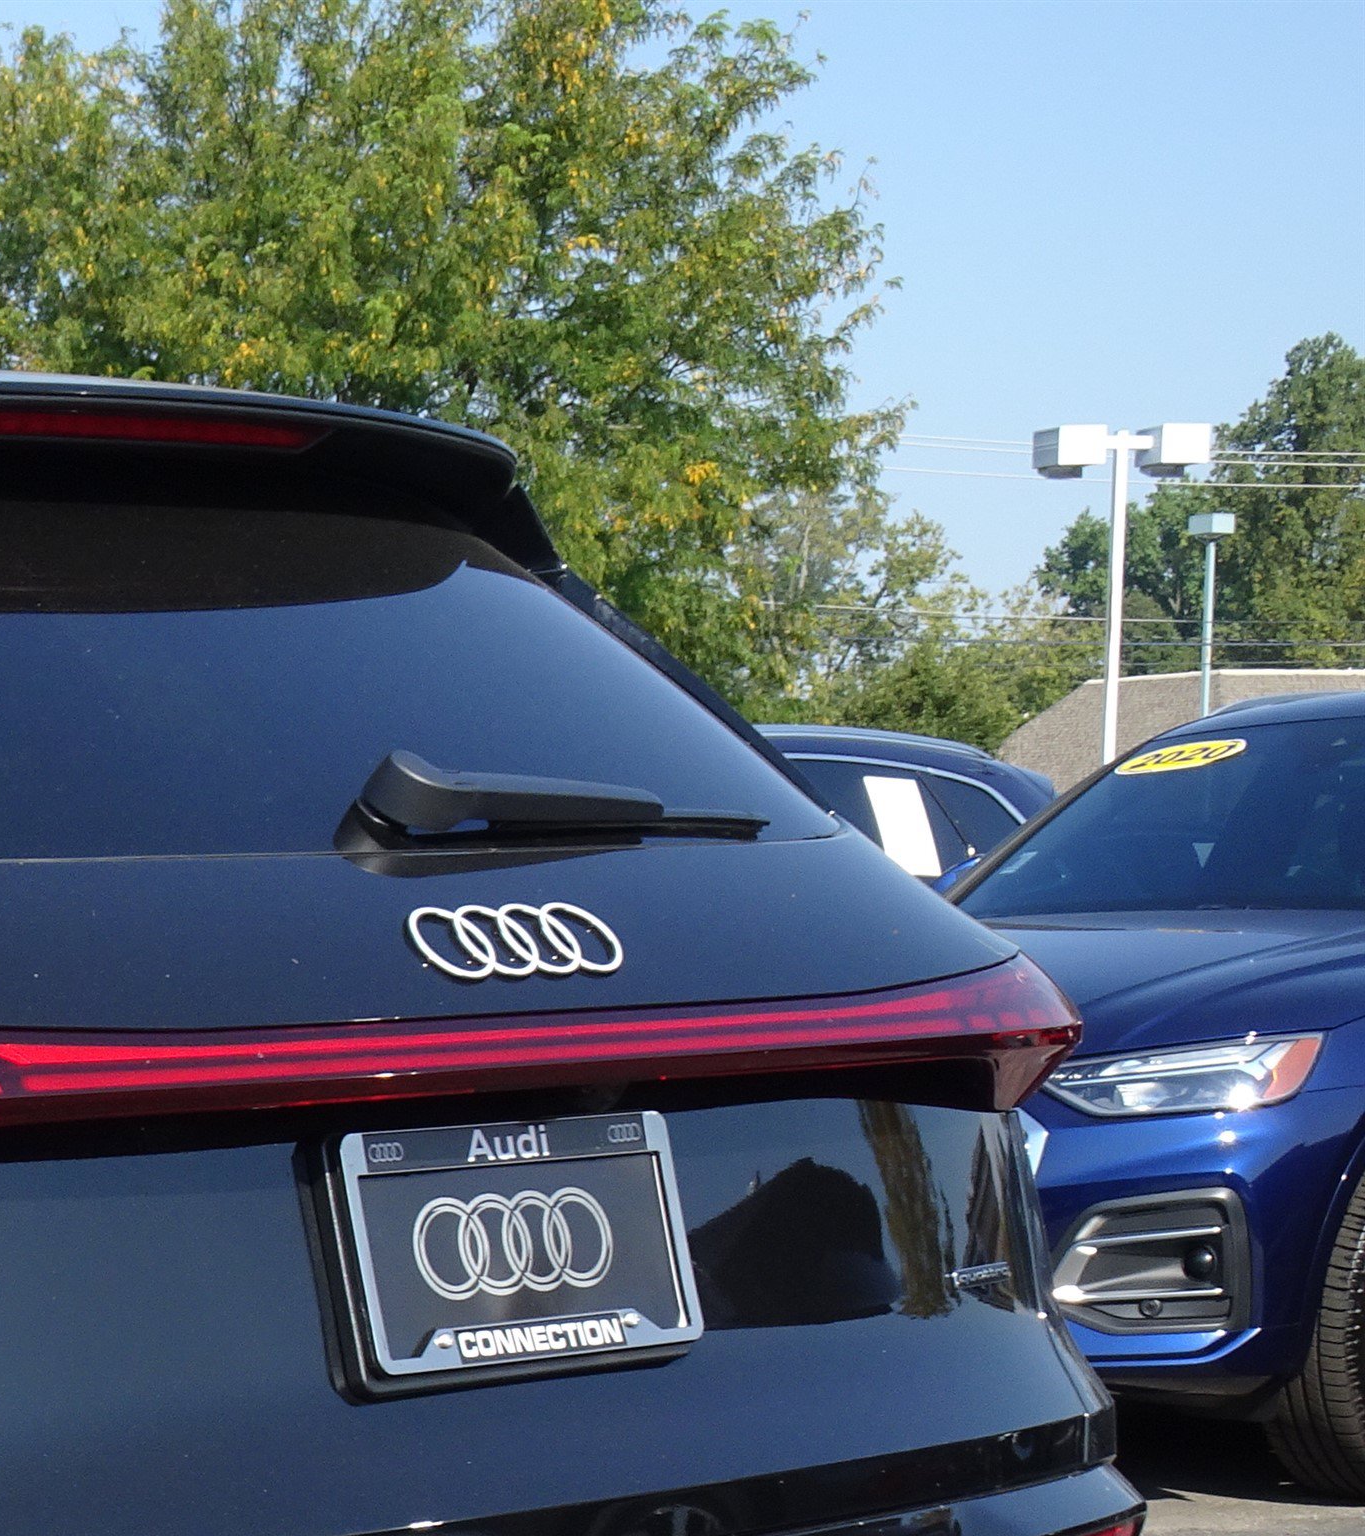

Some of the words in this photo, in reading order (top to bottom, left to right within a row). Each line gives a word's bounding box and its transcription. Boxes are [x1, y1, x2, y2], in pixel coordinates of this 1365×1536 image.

[1128, 743, 1236, 769] 2020
[467, 1124, 551, 1163] Audi
[457, 1317, 624, 1358] CONNECTION
